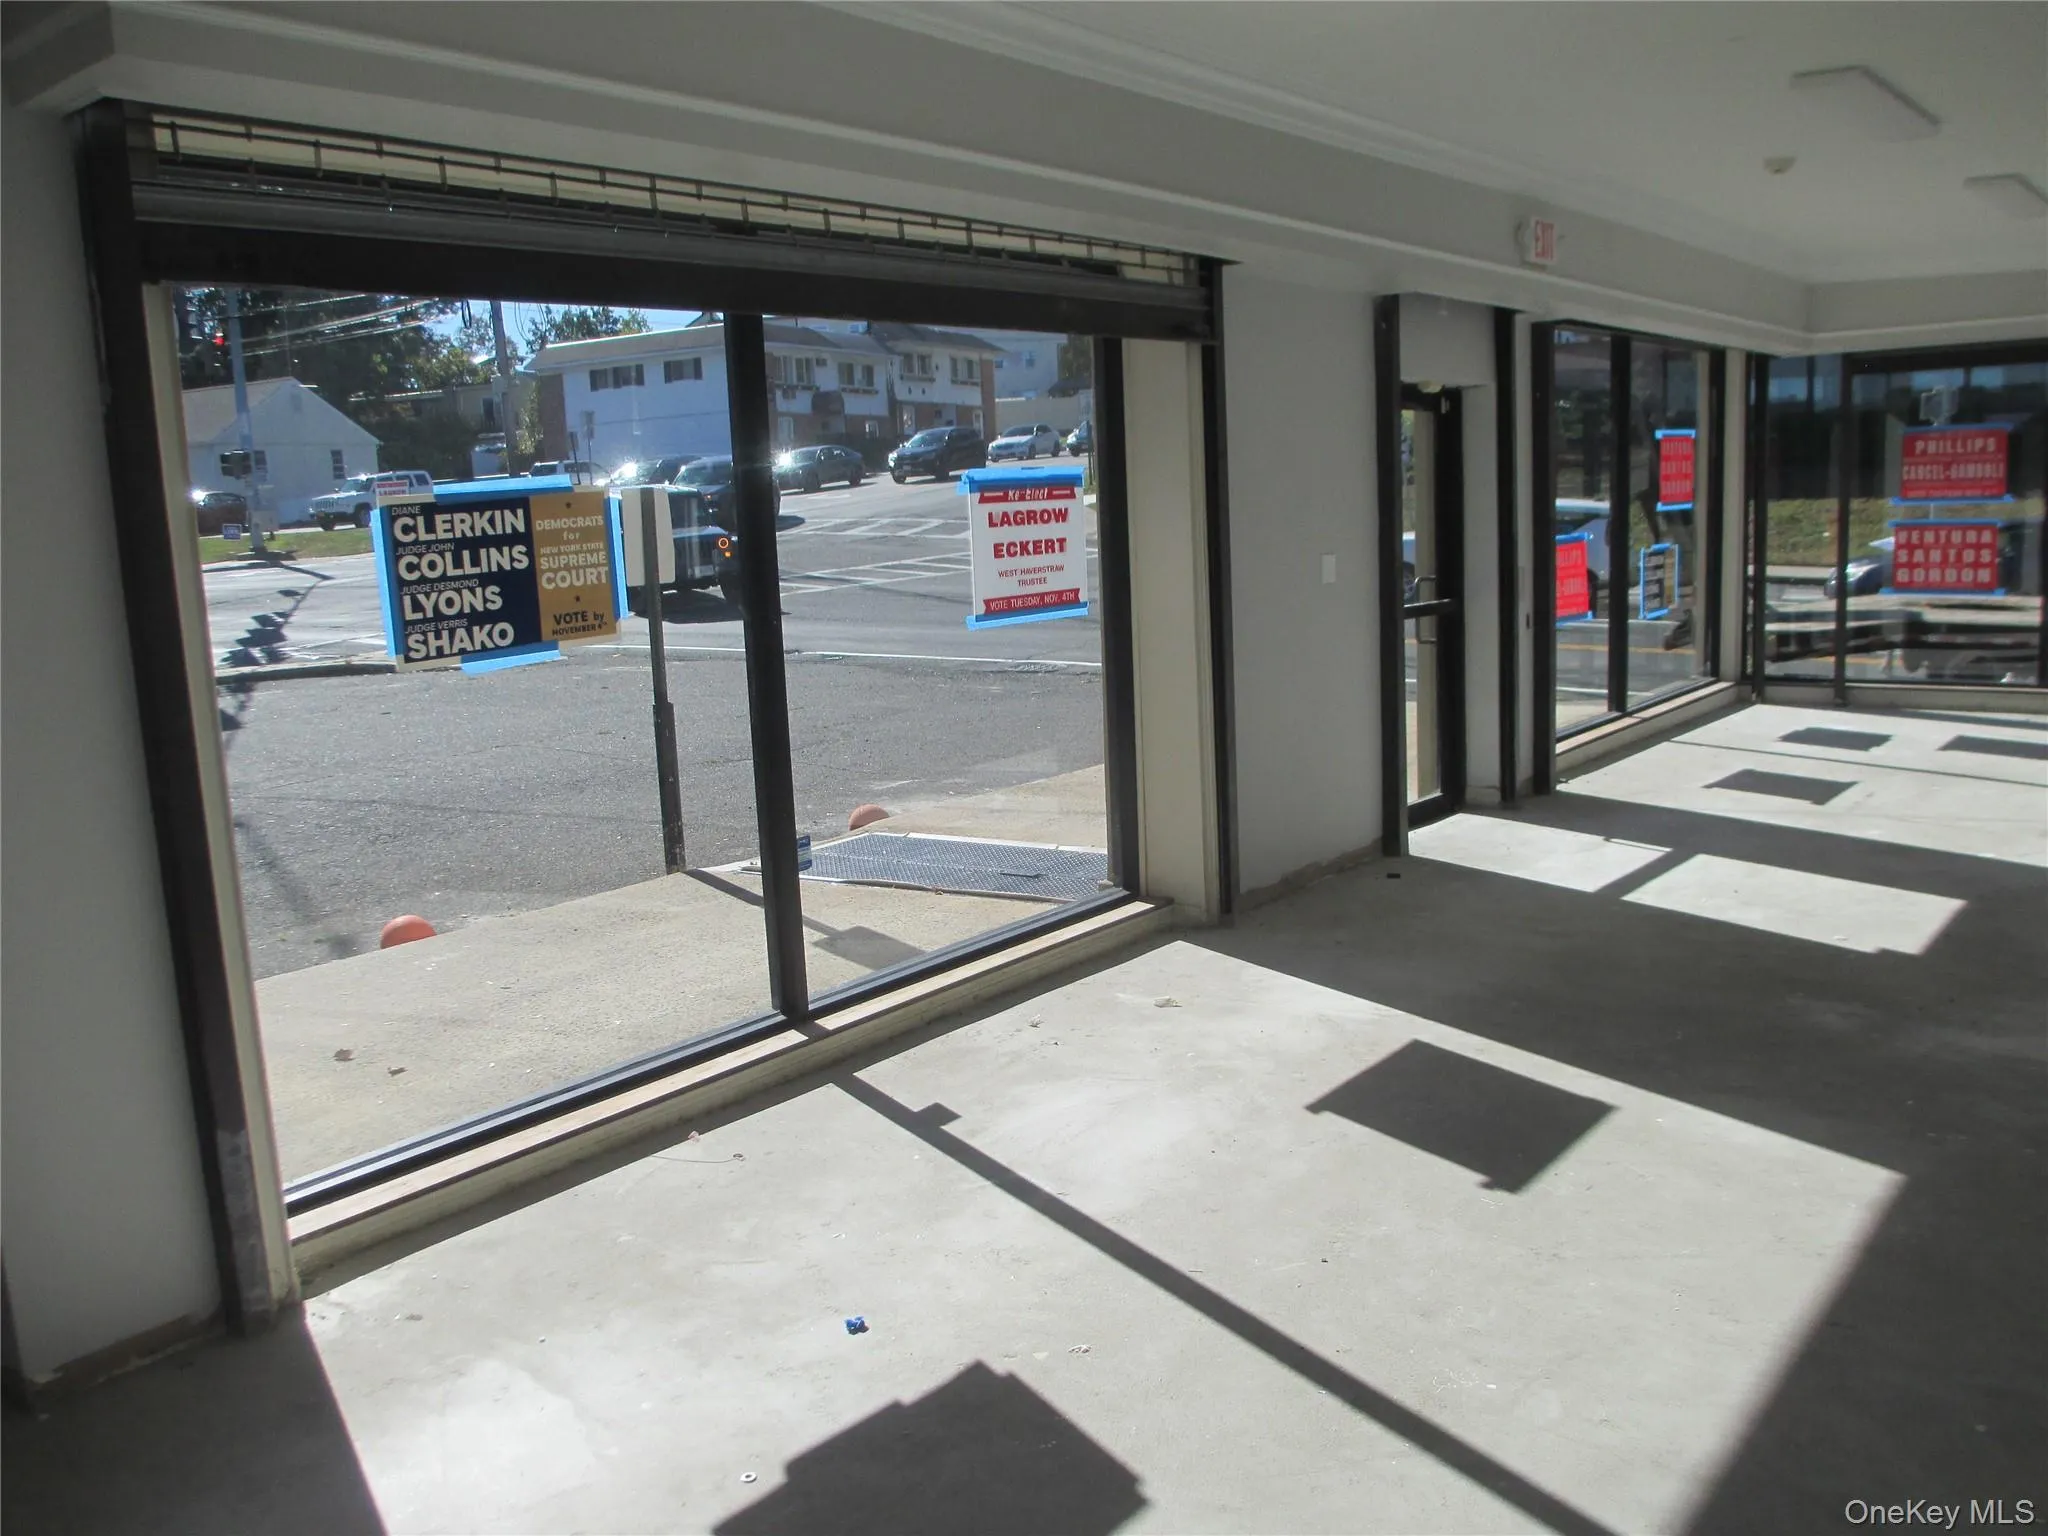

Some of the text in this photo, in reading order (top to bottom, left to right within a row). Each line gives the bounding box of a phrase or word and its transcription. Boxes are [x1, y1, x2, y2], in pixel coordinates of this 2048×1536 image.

[1534, 219, 1555, 261] EXIT
[392, 505, 420, 516] DIANE
[987, 507, 1069, 528] LAGROW
[393, 508, 526, 543] CLERKIN
[535, 515, 604, 531] DEMOCRATS
[562, 531, 580, 541] for
[396, 542, 455, 555] JUDGE JOHN
[540, 542, 604, 554] NEW YORK STATE
[993, 537, 1067, 559] ECKERT
[397, 545, 530, 581] COLLINS
[540, 551, 607, 570] SUPREME
[541, 566, 609, 589] COURT
[998, 564, 1065, 578] WEST HAVERSTRAW
[400, 579, 479, 595] JUDGE DESMOND
[1017, 577, 1048, 587] TRUSTEE
[403, 585, 503, 621] LYONS
[990, 599, 1008, 611] VOTE
[1044, 594, 1060, 604] NOV.
[1061, 591, 1075, 601] 4TH
[405, 618, 469, 634] JUDGE VERRIS
[553, 610, 605, 626] VOTE by
[552, 623, 597, 637] NOVEMBER
[407, 621, 515, 660] SHAKO
